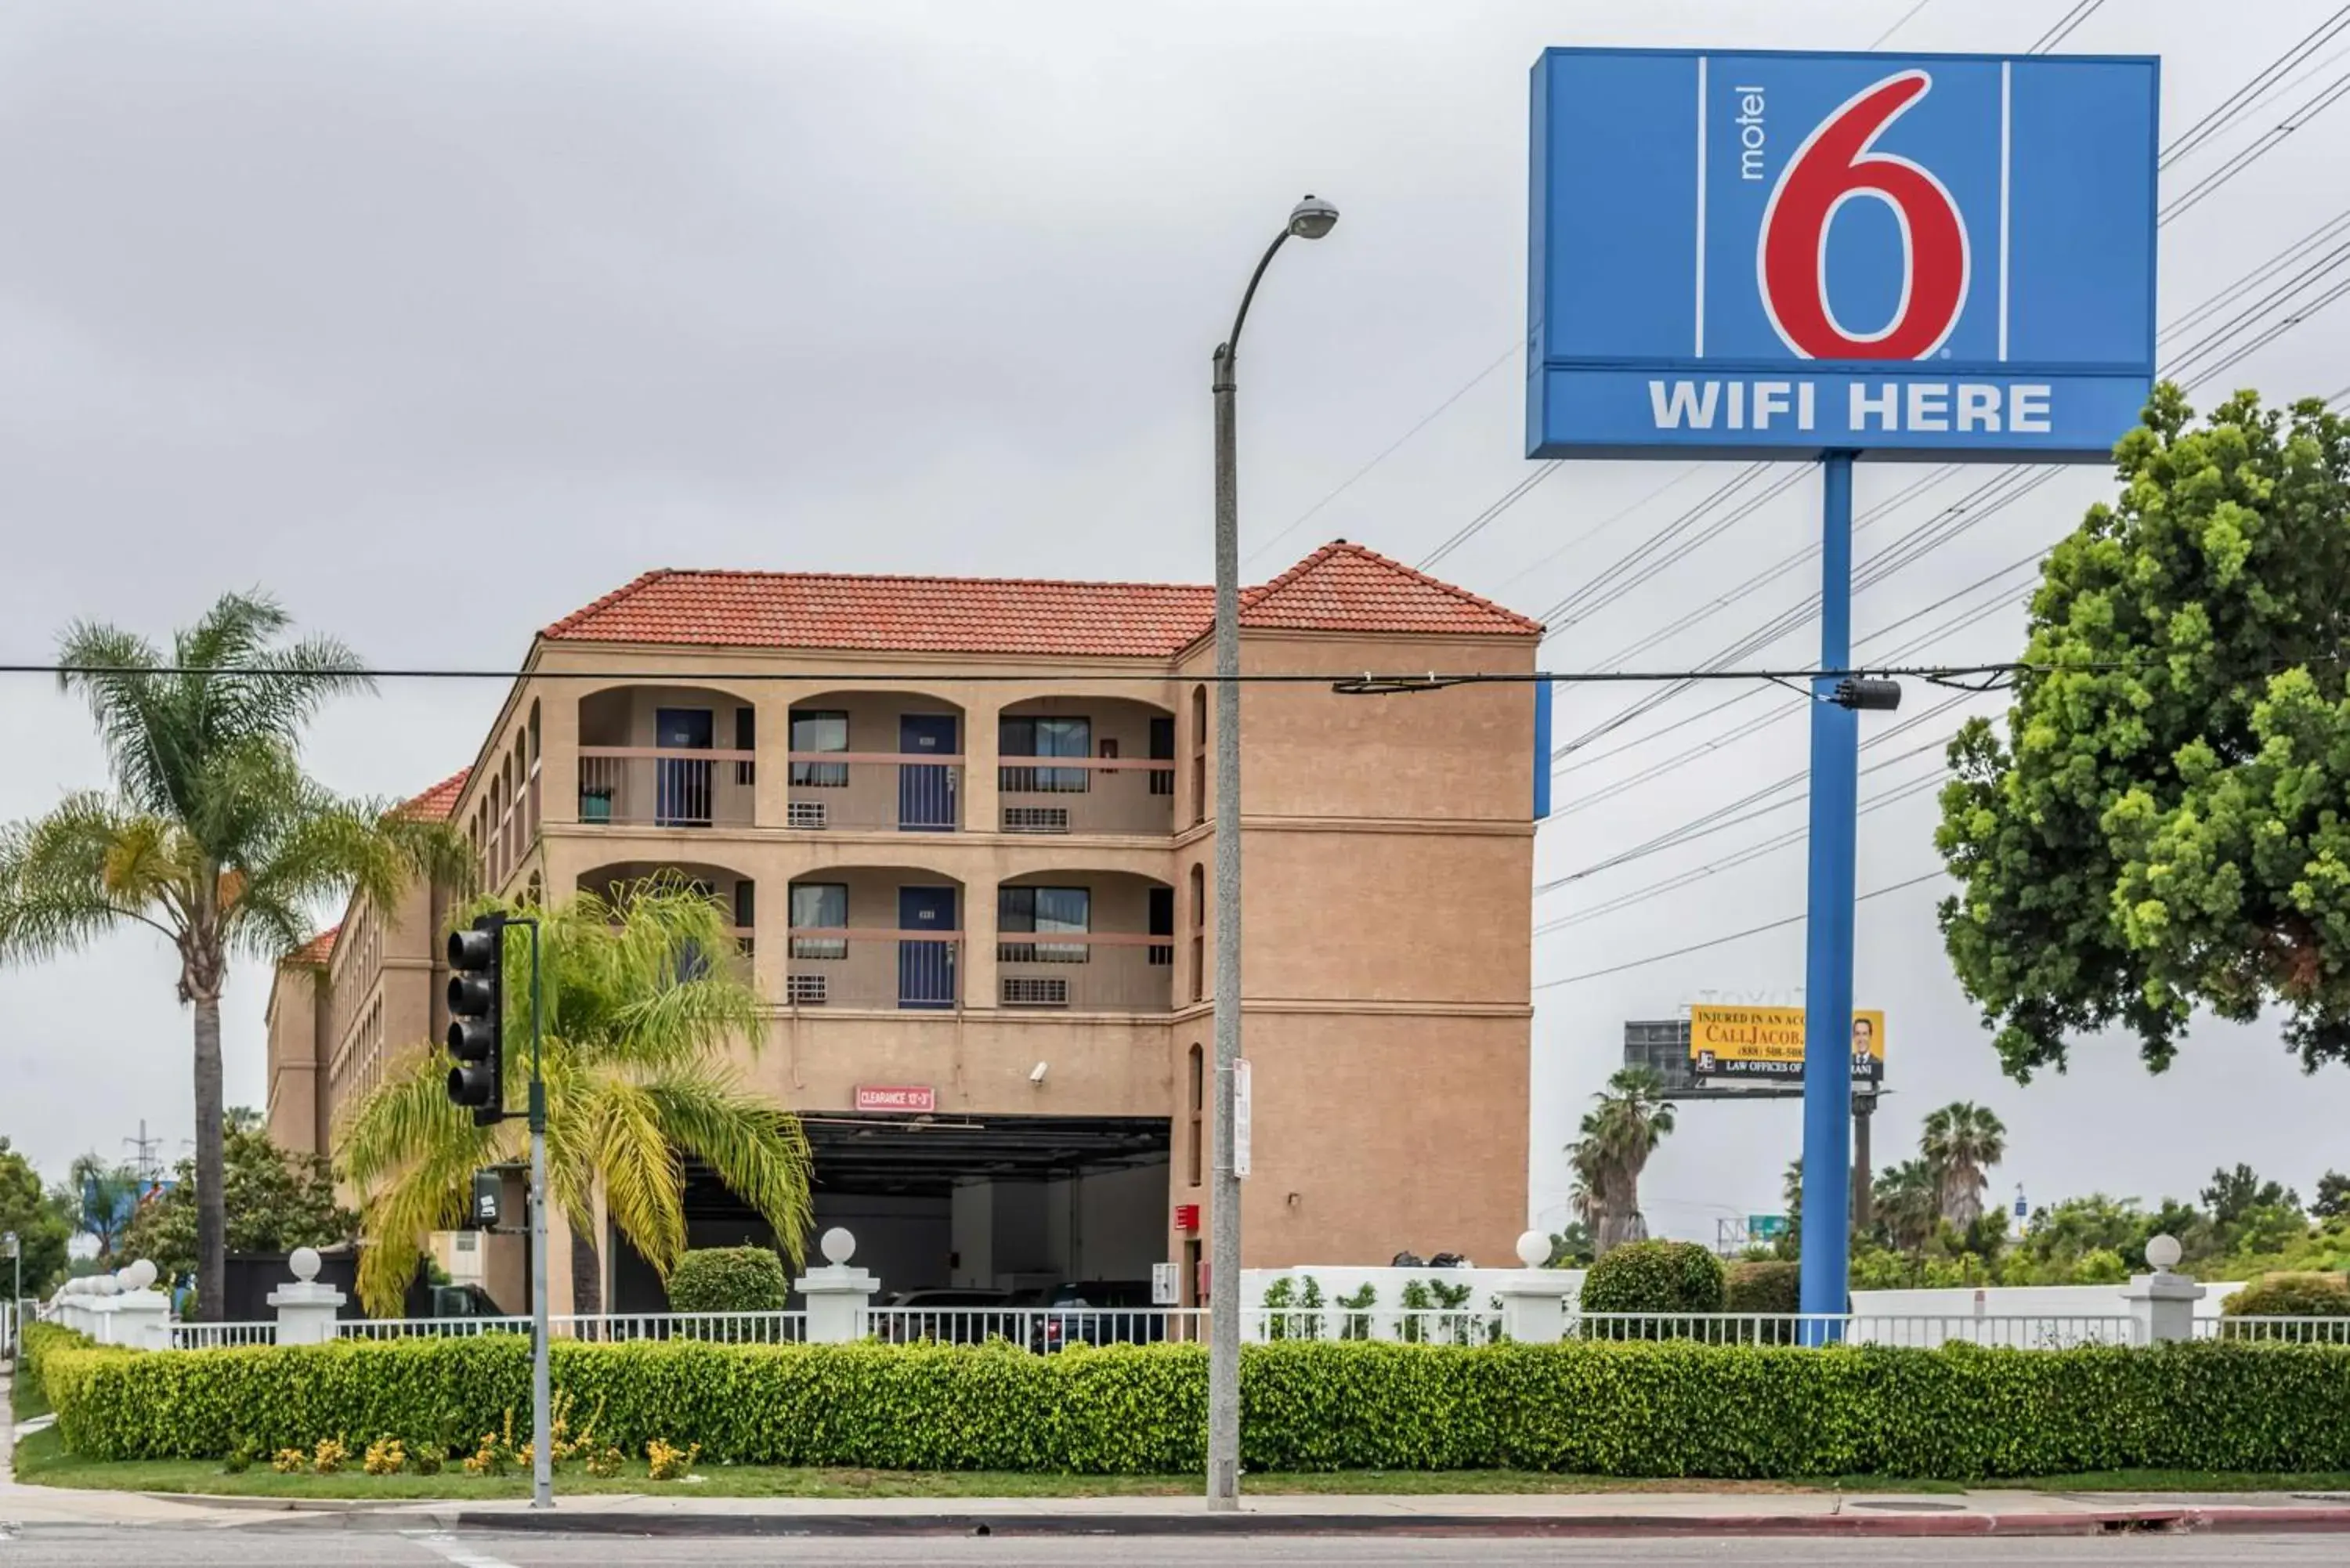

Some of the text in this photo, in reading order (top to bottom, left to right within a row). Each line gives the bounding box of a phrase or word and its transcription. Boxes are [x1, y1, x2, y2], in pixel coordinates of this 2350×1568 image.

[1735, 68, 1972, 360] motel 6
[1649, 381, 2052, 432] WIFI HERE
[1697, 1011, 1748, 1023] INJURED
[1751, 1013, 1762, 1024] IN
[1768, 1015, 1781, 1024] AN
[1706, 1024, 1805, 1045] CALLJACOB.
[1726, 1061, 1748, 1071] LAW
[1749, 1061, 1788, 1072] OFFICES
[862, 1091, 906, 1104] CLEARANCE
